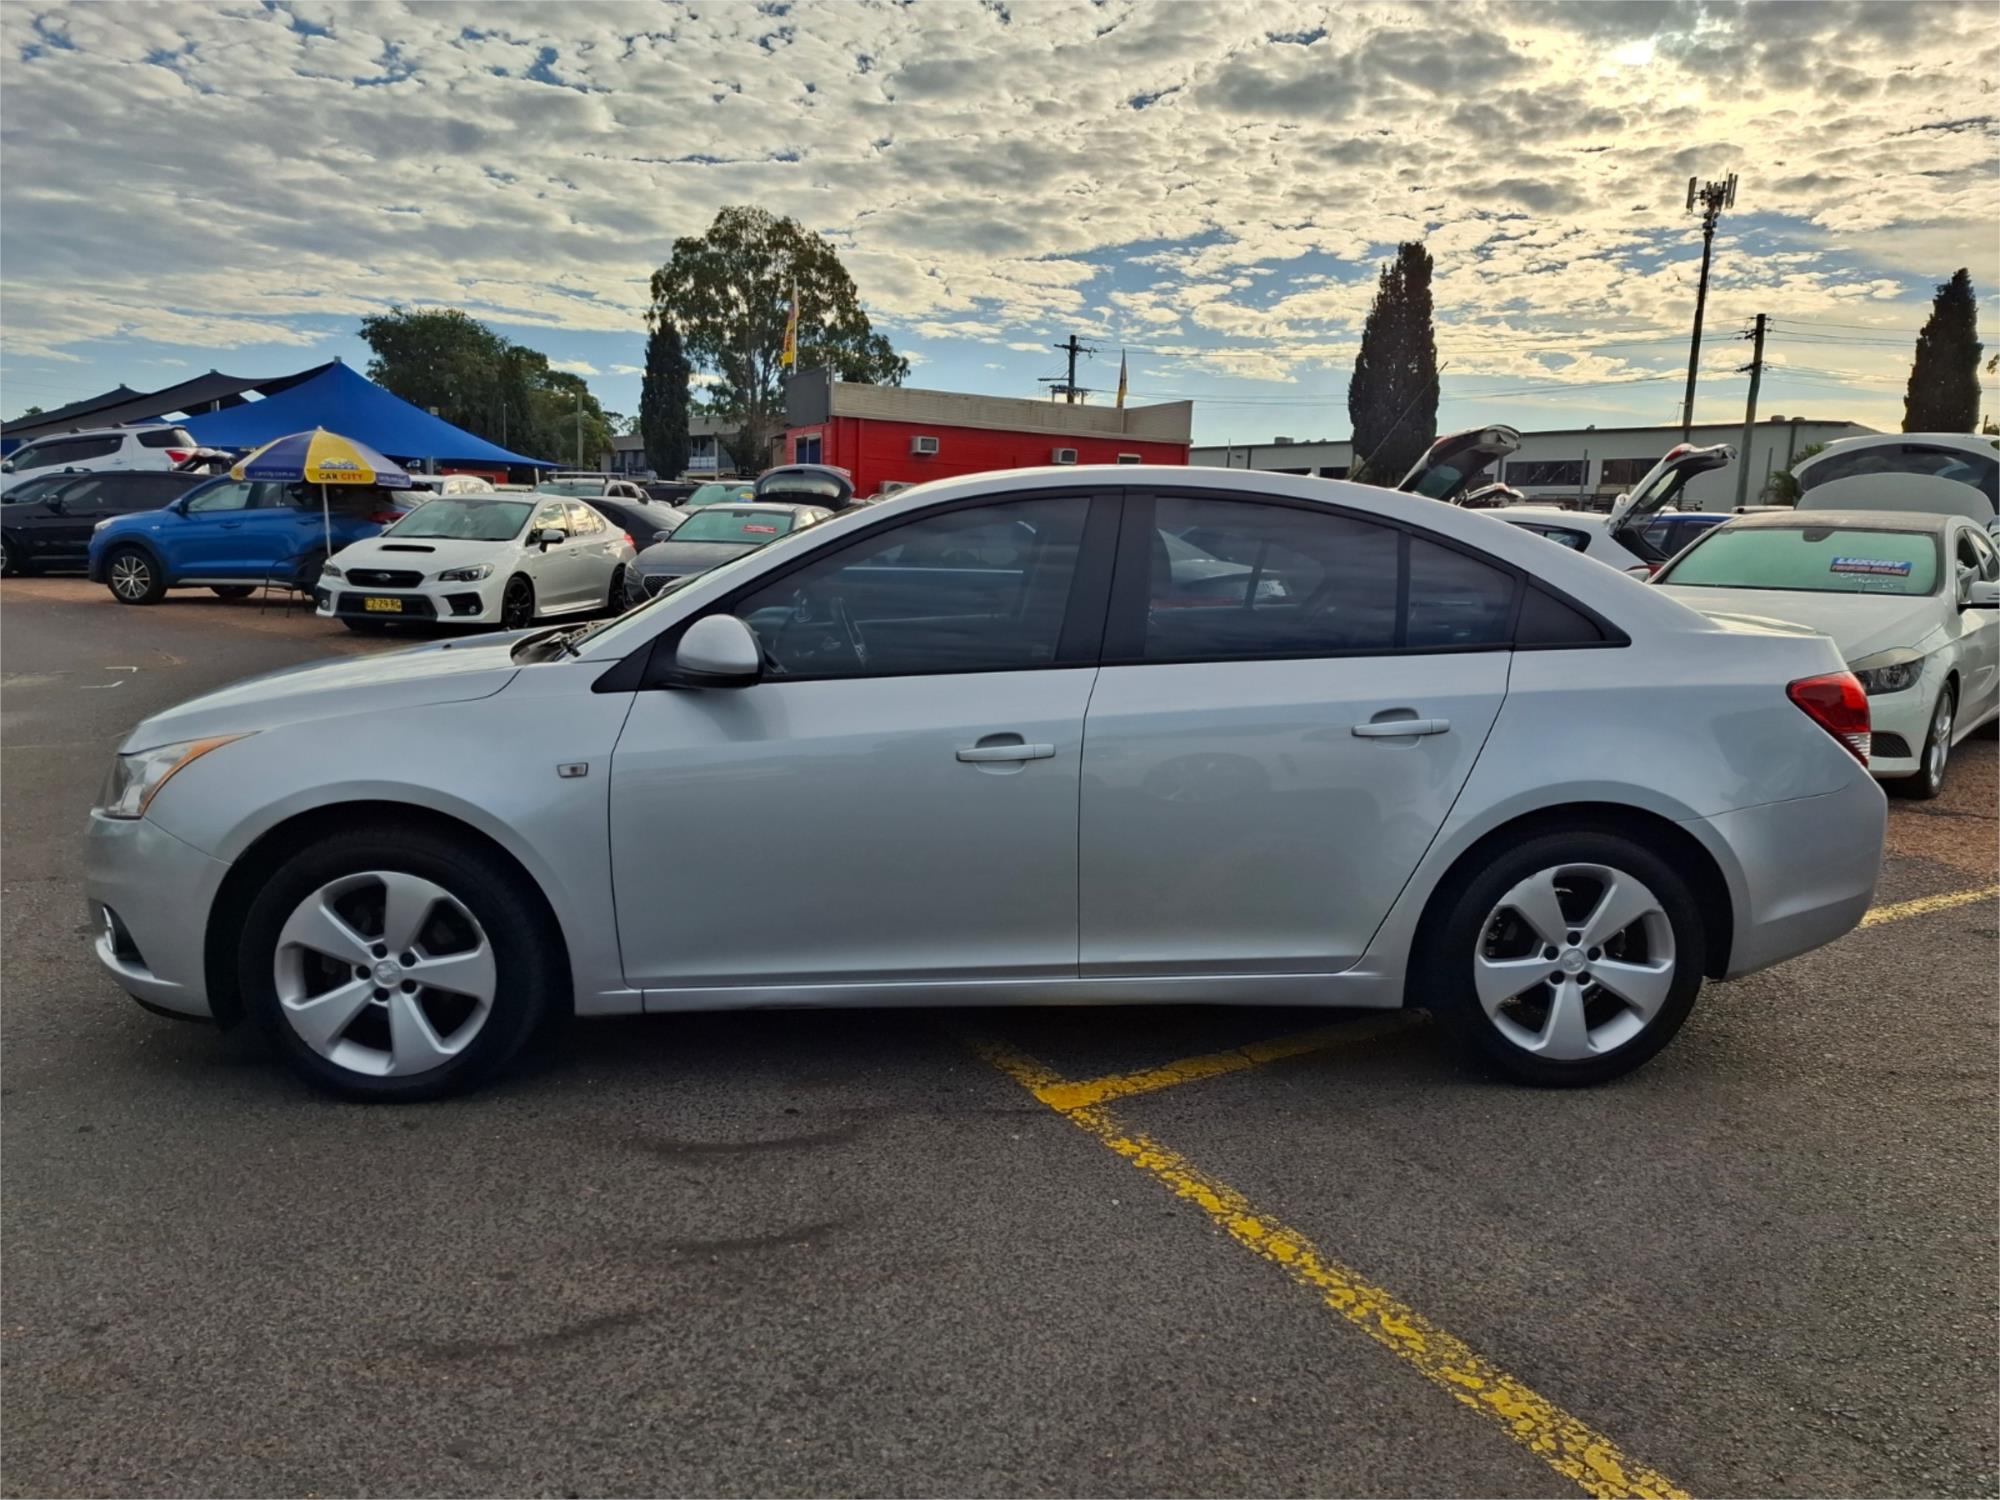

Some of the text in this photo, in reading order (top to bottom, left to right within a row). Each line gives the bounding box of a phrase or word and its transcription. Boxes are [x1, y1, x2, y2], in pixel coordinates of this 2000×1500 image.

[318, 473, 363, 481] CAR CITY
[1836, 557, 1907, 569] LUXURY
